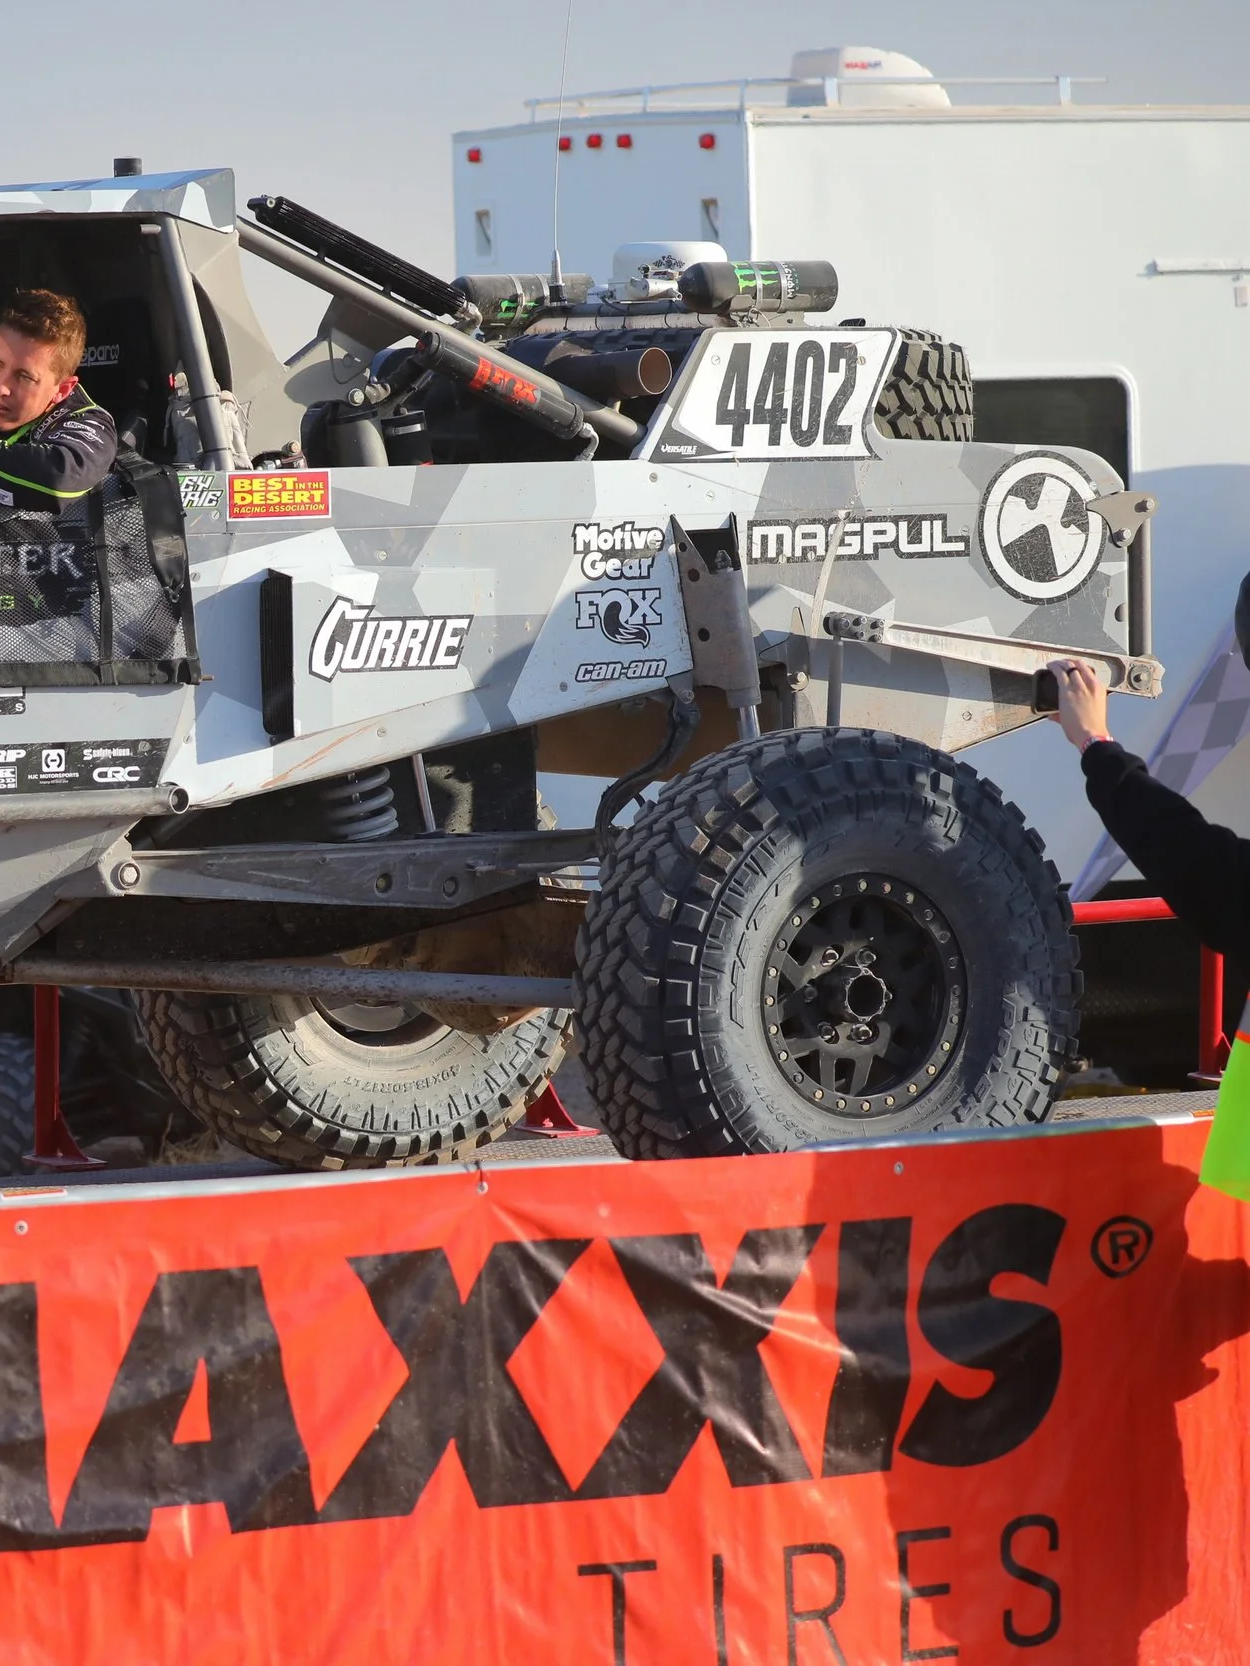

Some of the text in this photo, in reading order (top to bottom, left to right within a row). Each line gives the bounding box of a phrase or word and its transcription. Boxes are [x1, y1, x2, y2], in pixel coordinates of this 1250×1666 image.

[716, 340, 858, 447] 4402
[234, 477, 297, 491] BEST
[234, 490, 325, 505] DESERT
[234, 504, 325, 514] RACING ASSOCIATION
[575, 523, 665, 552] Motive
[751, 520, 965, 558] MAGPUL
[583, 551, 654, 579] Gear
[575, 587, 662, 645] FOX
[310, 598, 472, 681] CURRIE
[576, 660, 667, 681] can-am
[93, 766, 141, 782] CRC
[577, 1513, 1062, 1666] TIRES
